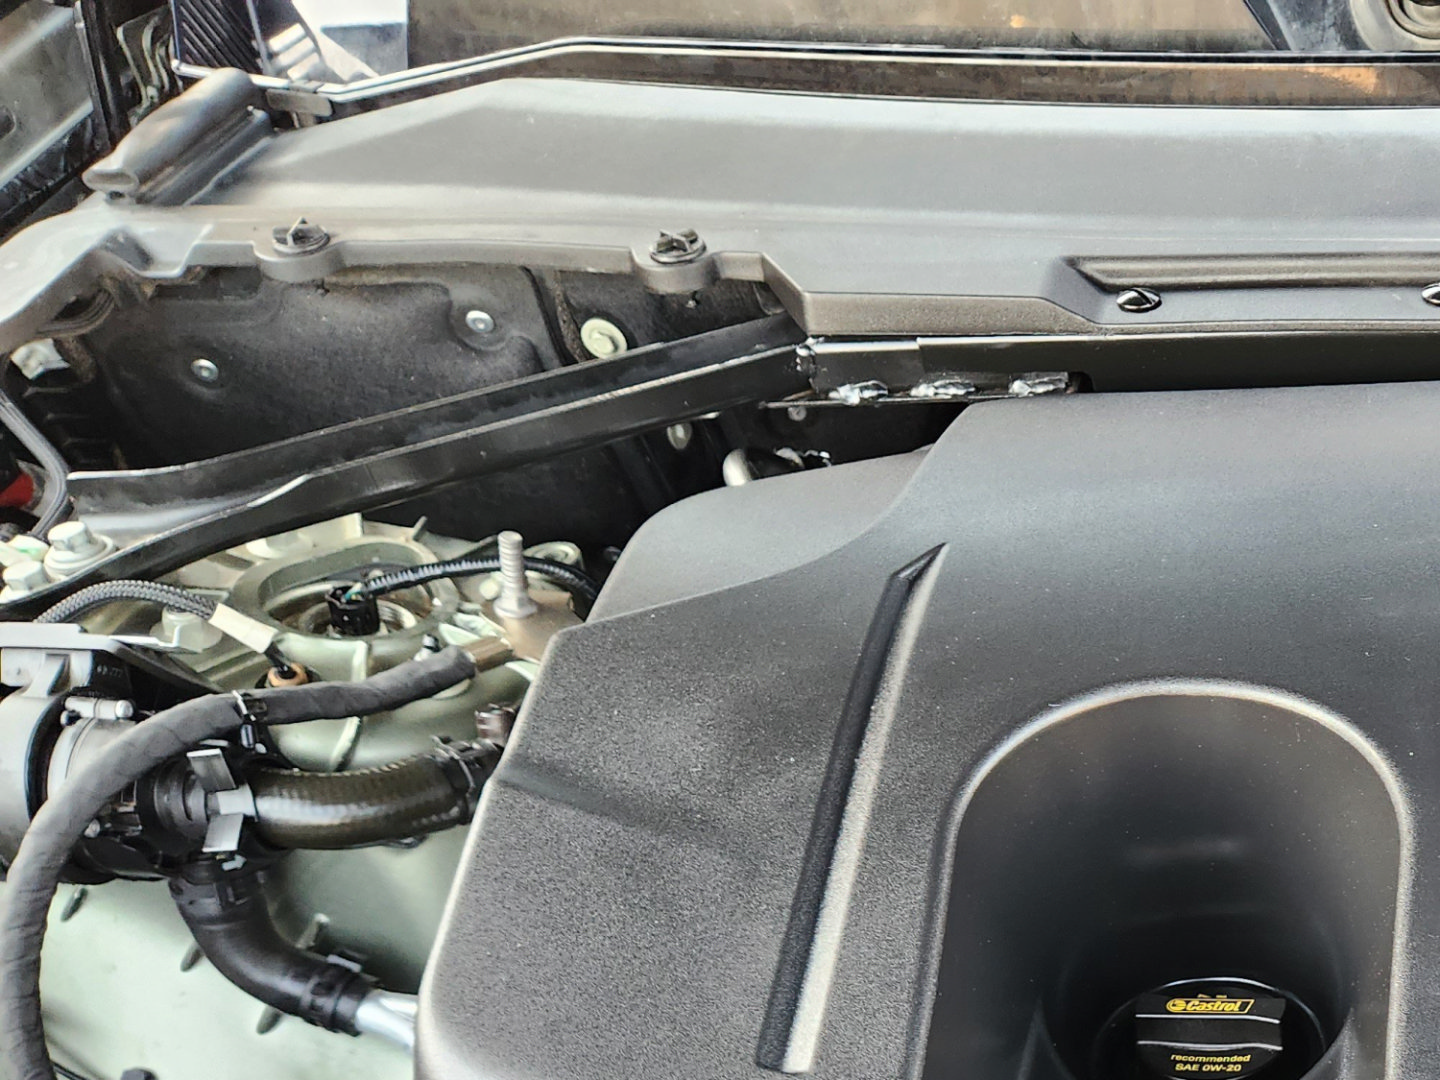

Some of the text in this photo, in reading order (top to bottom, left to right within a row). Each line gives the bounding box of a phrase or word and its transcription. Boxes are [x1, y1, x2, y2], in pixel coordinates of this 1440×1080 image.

[1186, 1000, 1242, 1012] Castrol
[1171, 1054, 1252, 1063] recommended
[1175, 1063, 1242, 1072] SAE 0W-20
